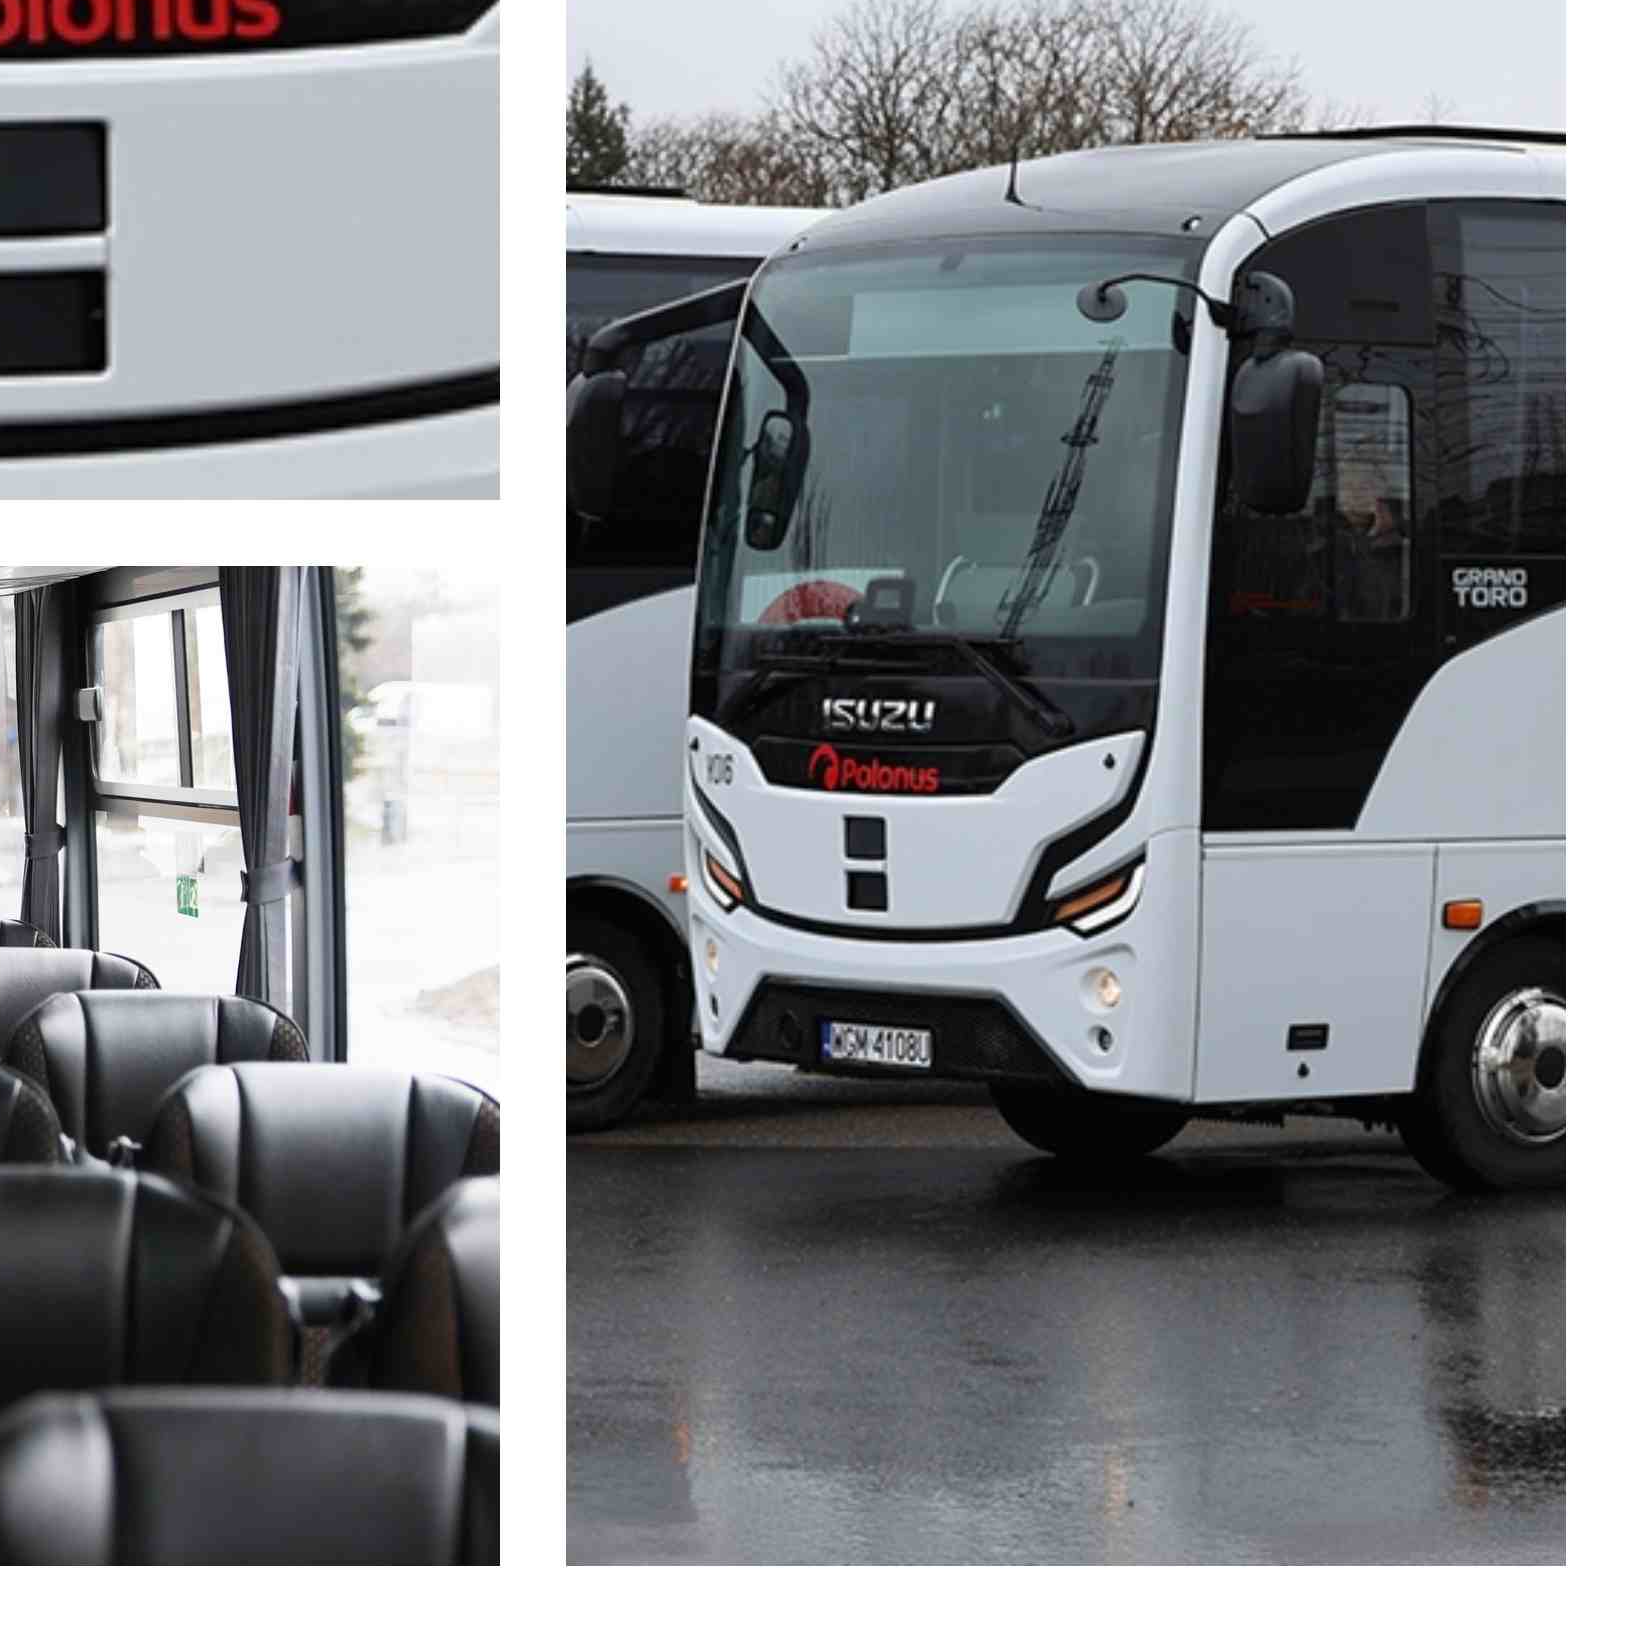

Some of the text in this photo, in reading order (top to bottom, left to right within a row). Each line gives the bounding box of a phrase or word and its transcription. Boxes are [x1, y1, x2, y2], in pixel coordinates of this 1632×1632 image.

[1451, 568, 1527, 586] GRAND
[1453, 585, 1528, 607] TORO
[823, 698, 935, 730] ISUZU
[841, 756, 939, 792] Polonus
